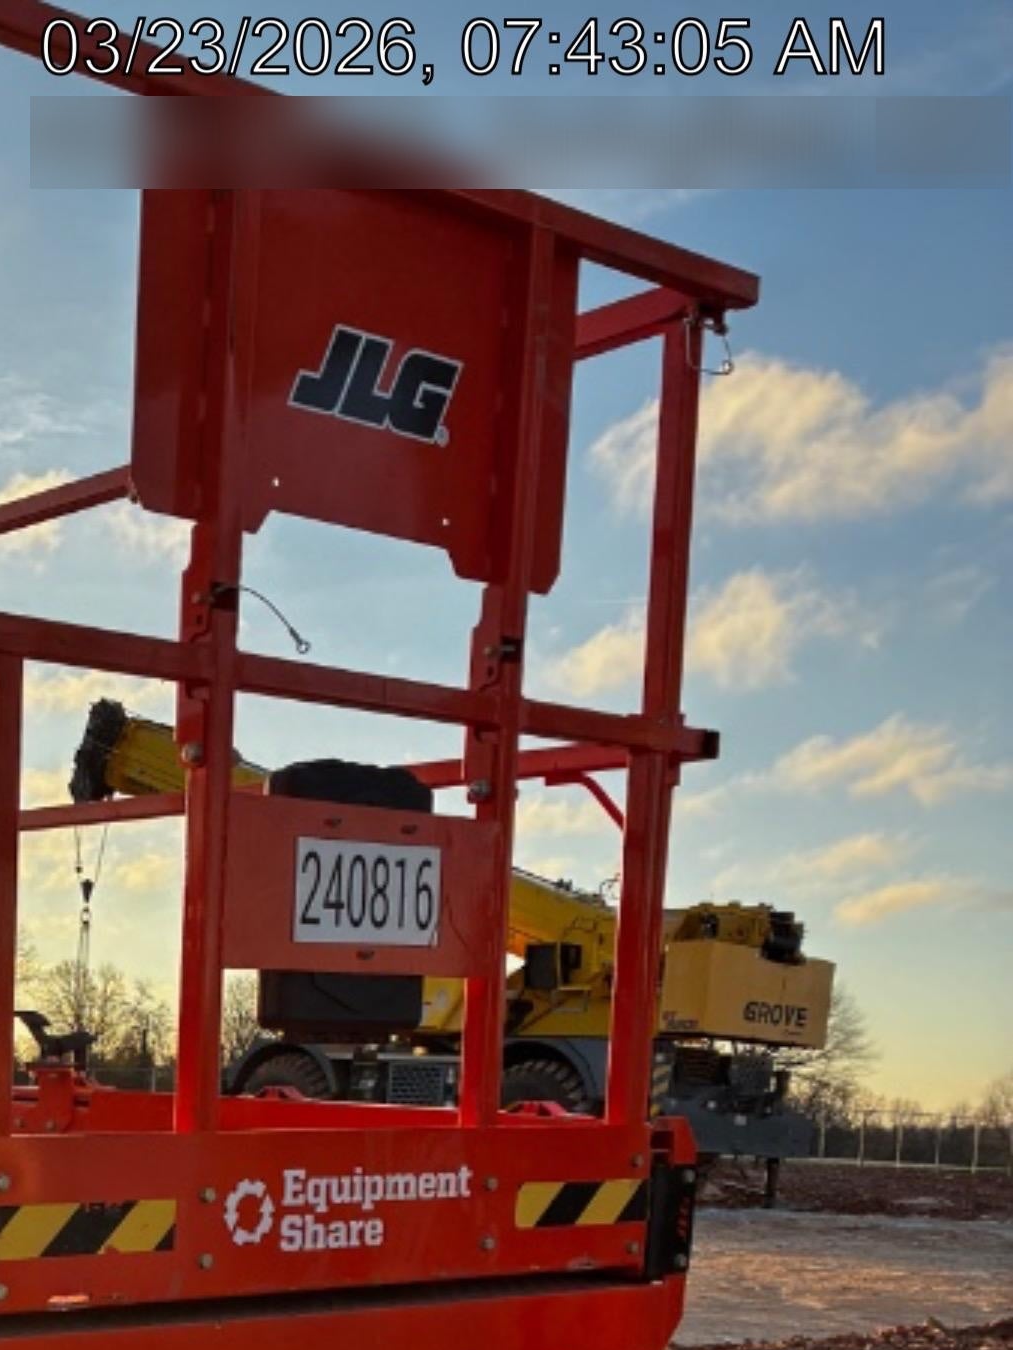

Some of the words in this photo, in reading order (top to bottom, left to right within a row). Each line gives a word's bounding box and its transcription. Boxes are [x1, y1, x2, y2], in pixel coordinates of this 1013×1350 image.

[287, 323, 464, 445] JLG
[299, 850, 435, 932] 240816
[743, 1001, 808, 1028] GROVE
[282, 1163, 472, 1213] Equipment
[279, 1213, 384, 1254] Share
